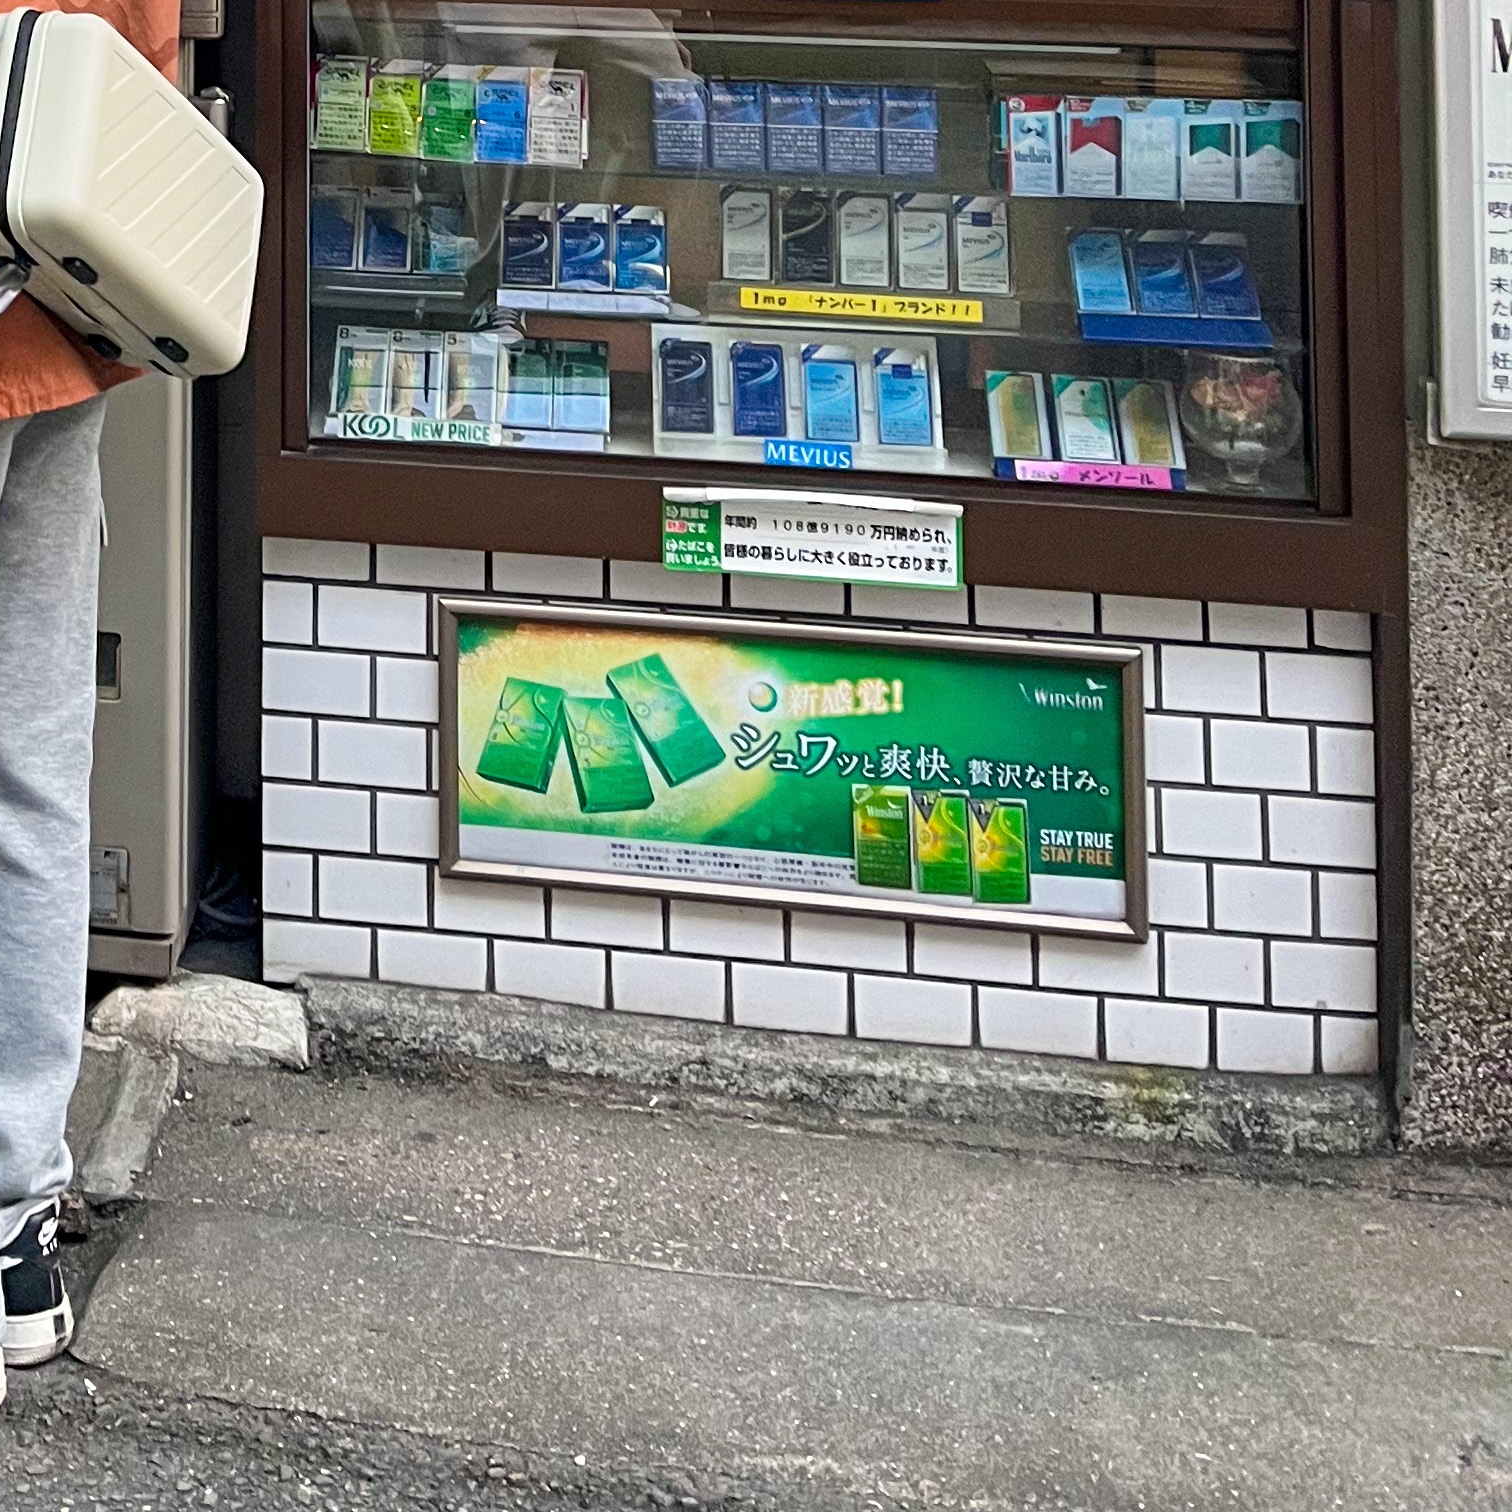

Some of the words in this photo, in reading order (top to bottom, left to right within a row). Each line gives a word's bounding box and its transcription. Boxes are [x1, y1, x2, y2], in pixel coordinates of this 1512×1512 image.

[342, 414, 405, 438] KOOL
[411, 421, 445, 439] NEW
[448, 423, 491, 441] PRICE
[767, 441, 852, 469] MEVIUS
[1033, 686, 1105, 712] Winston
[1040, 828, 1074, 846] STAY
[1075, 830, 1114, 850] TRUE
[1040, 846, 1074, 864] STAY
[1077, 848, 1114, 867] FREE
